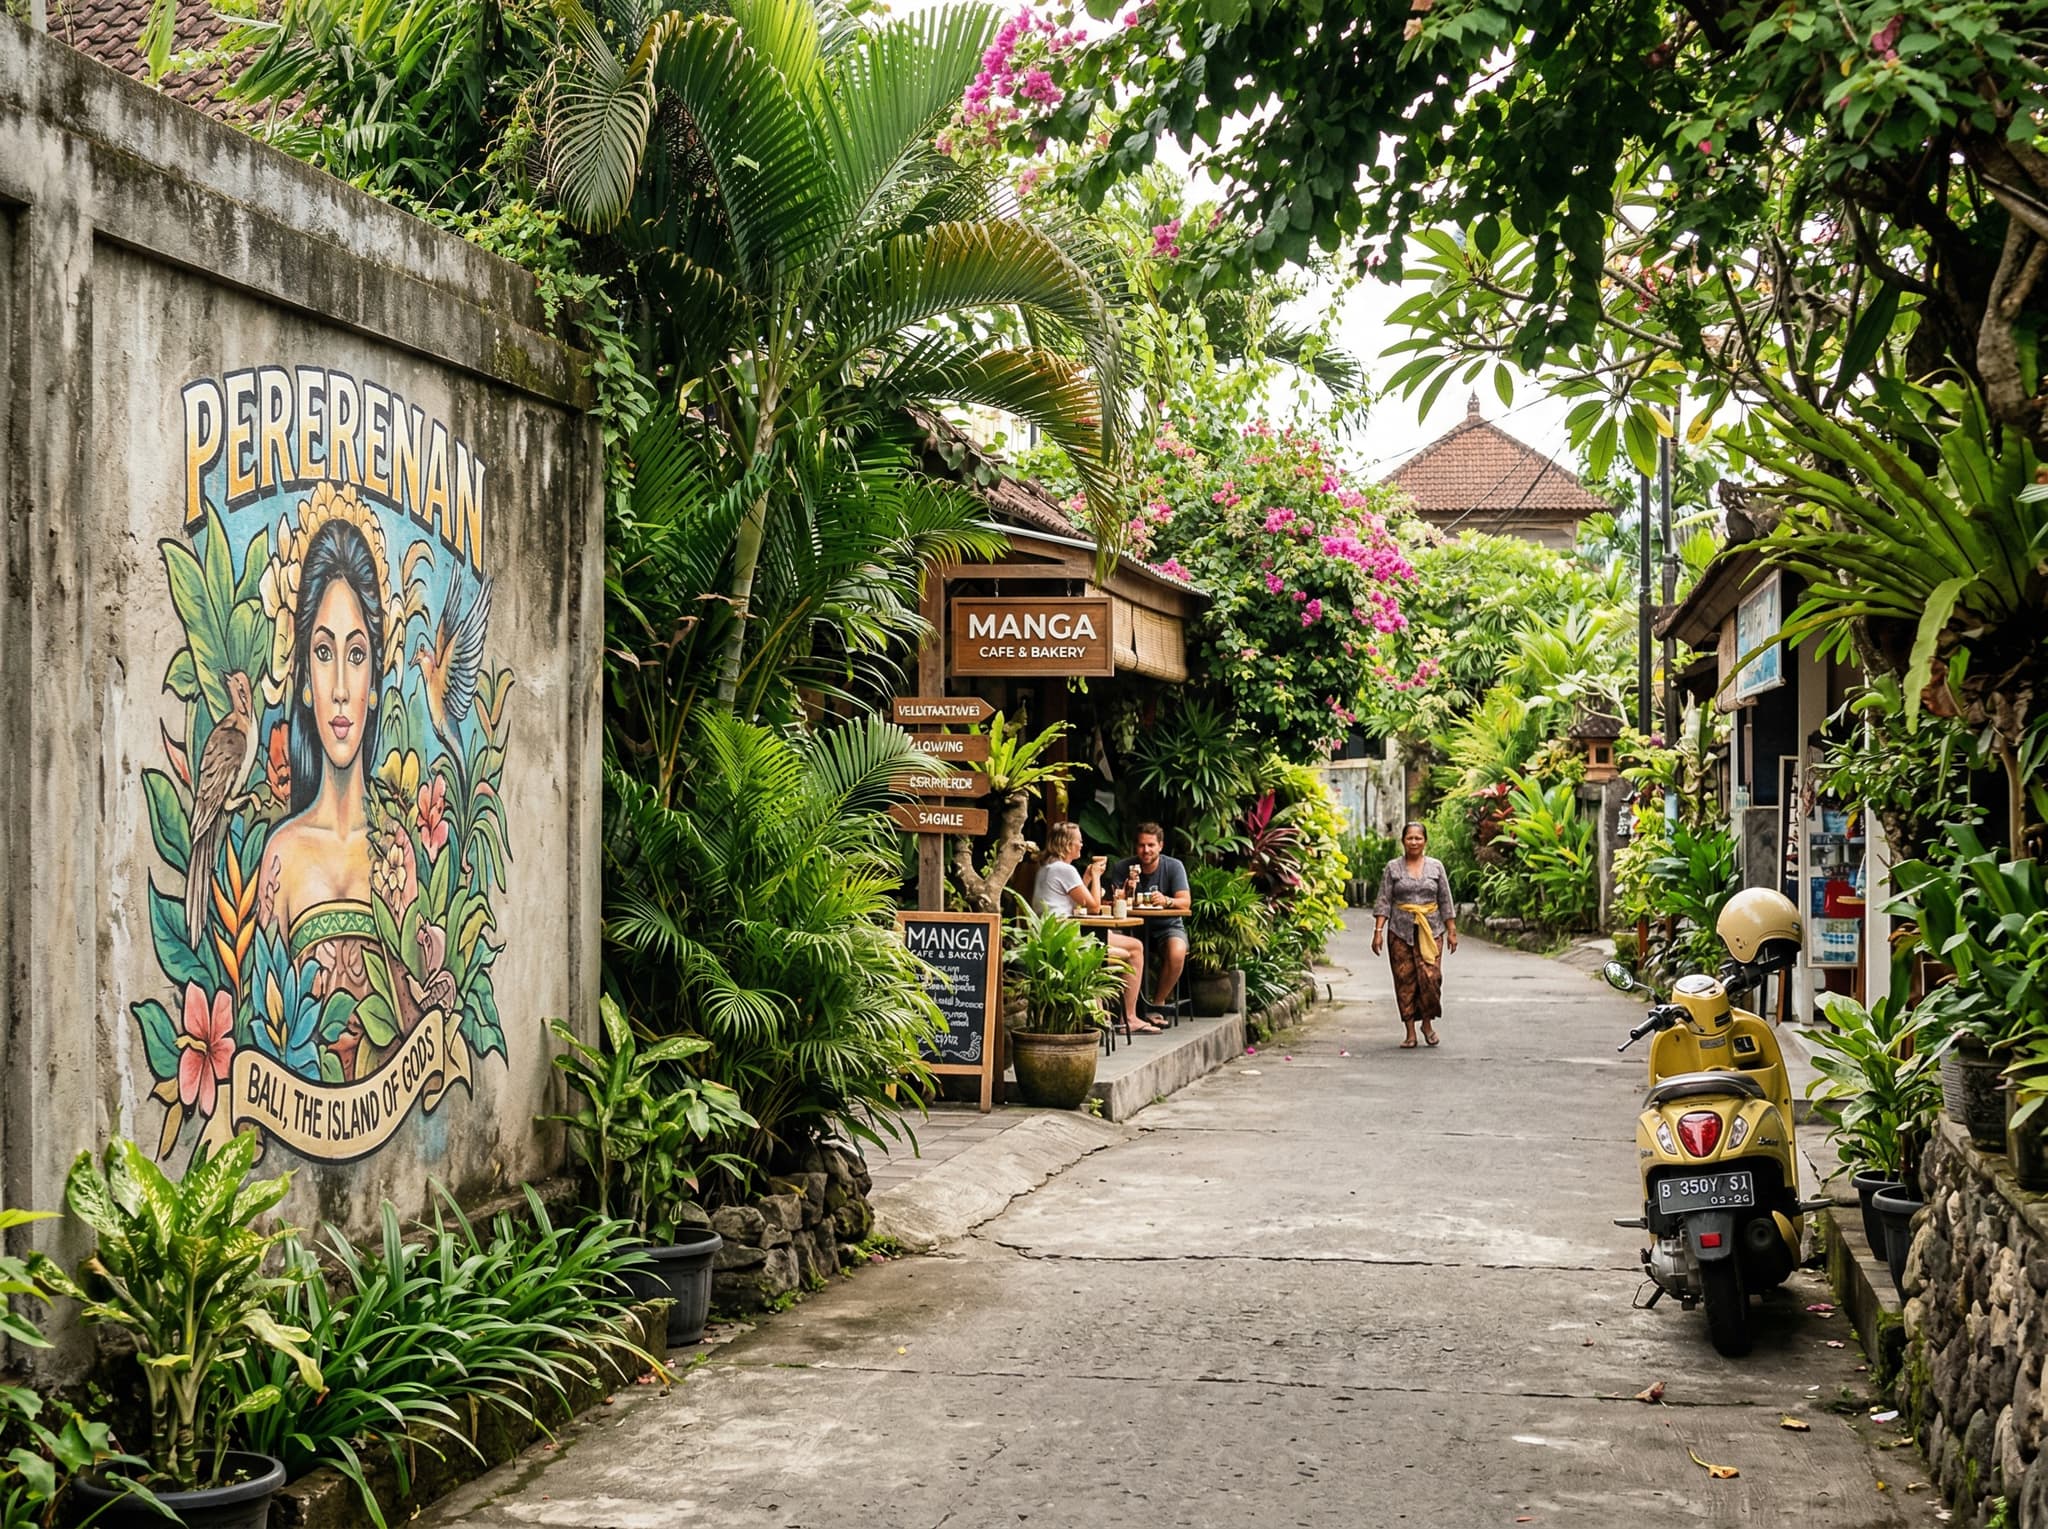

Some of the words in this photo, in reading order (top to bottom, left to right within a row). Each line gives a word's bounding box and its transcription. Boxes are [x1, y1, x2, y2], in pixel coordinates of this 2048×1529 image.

[182, 365, 487, 584] PERERENAN
[968, 613, 1097, 640] MANGA
[979, 646, 1015, 658] CAFE
[1018, 646, 1027, 658] &
[1031, 646, 1086, 658] BAKERY
[908, 926, 985, 951] MANGA
[247, 1062, 288, 1129] BALI,
[294, 1089, 322, 1139] THE
[327, 1090, 380, 1141] ISLAND
[382, 1070, 400, 1118] OF
[402, 1025, 435, 1093] GODS
[1662, 1184, 1671, 1197] B
